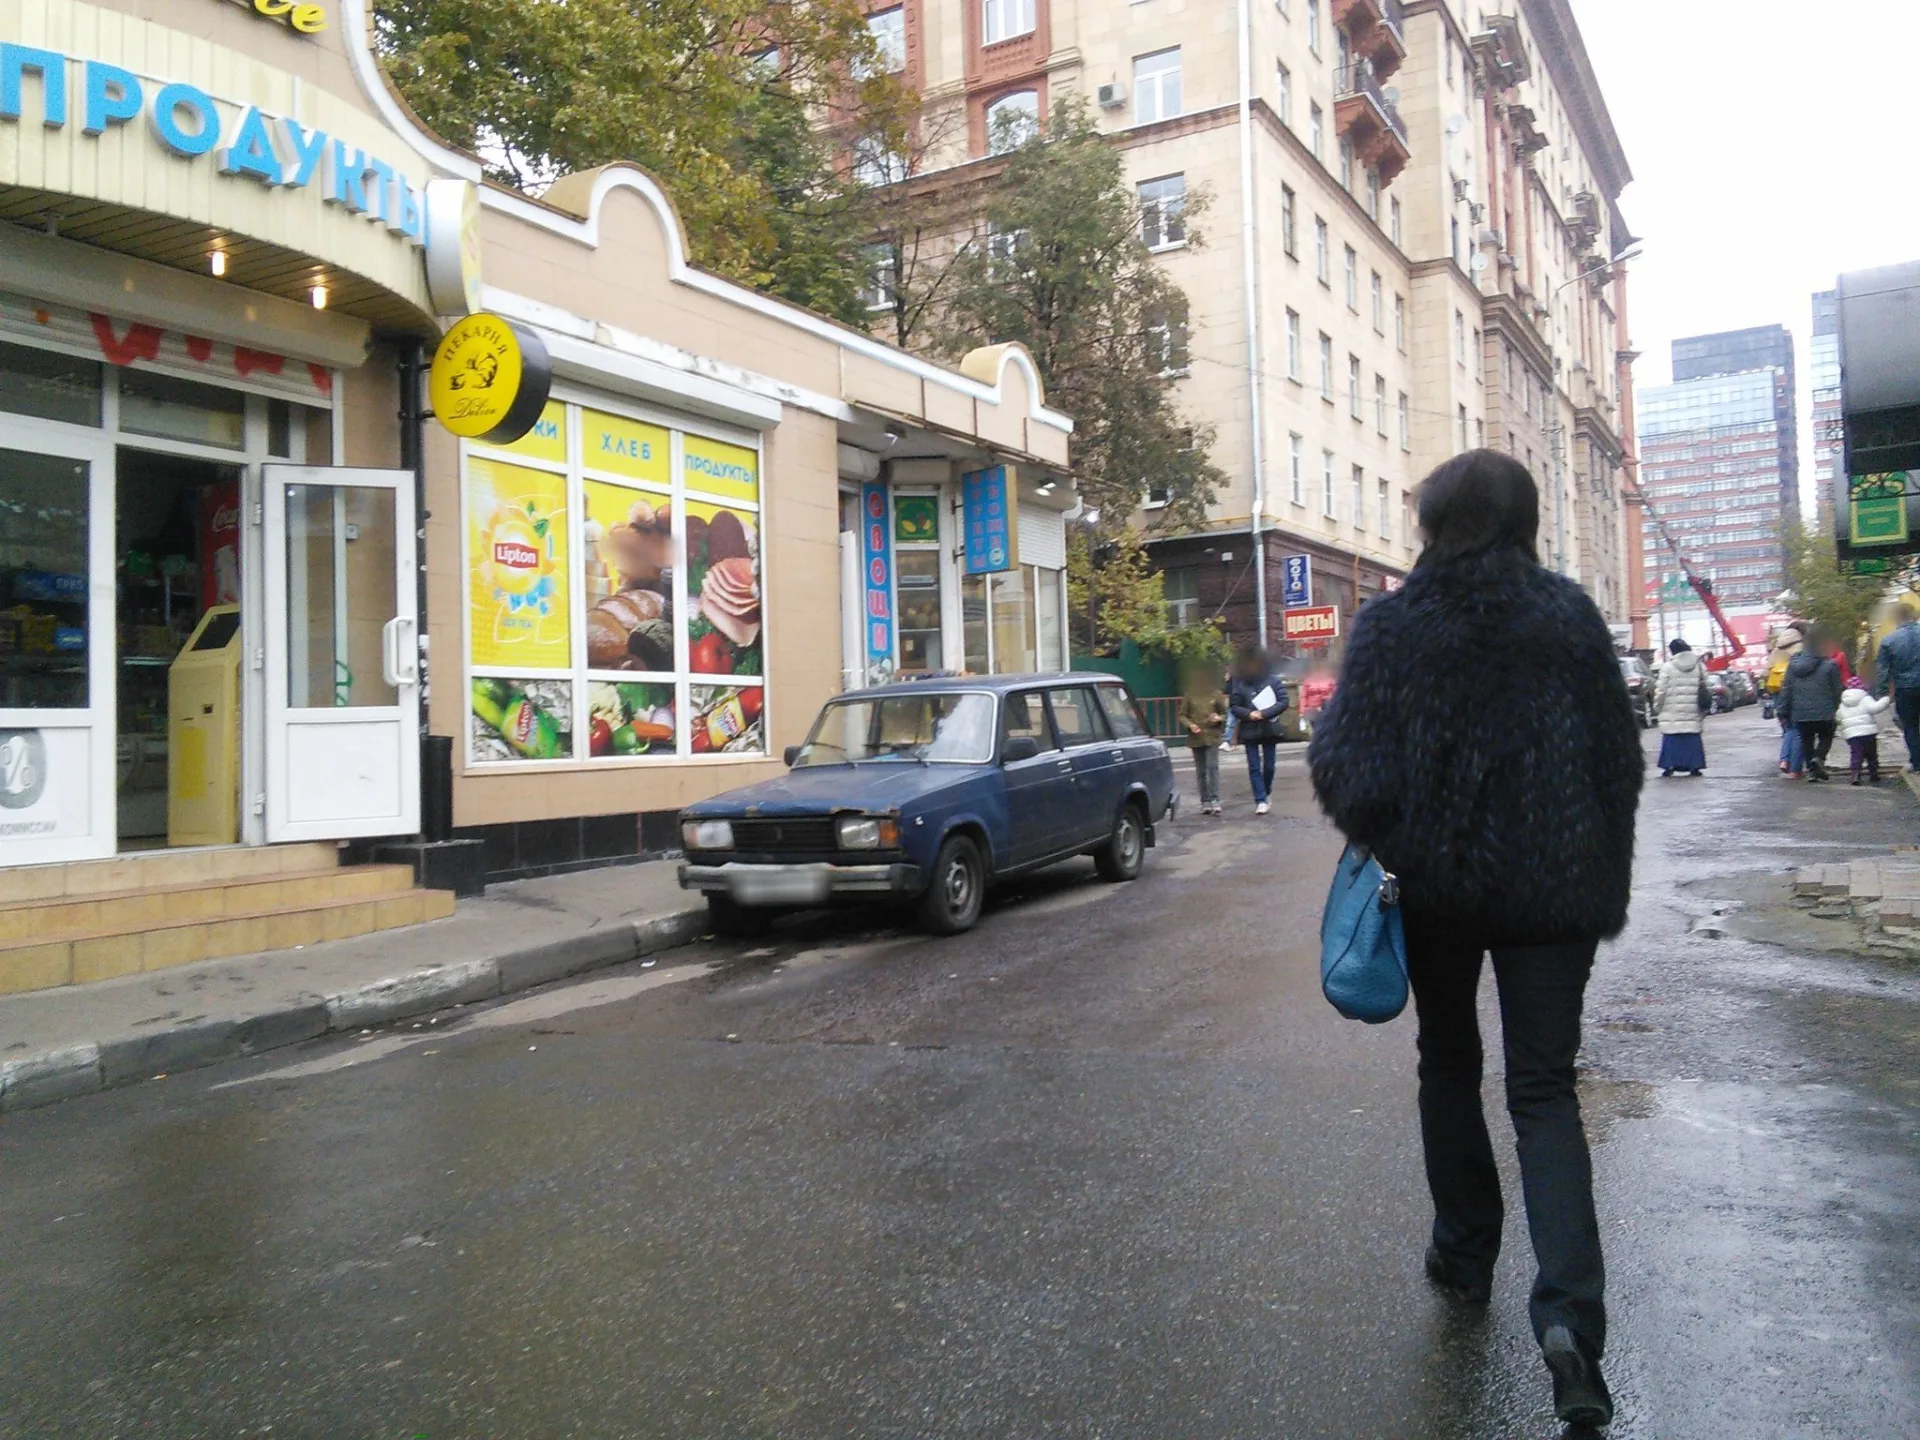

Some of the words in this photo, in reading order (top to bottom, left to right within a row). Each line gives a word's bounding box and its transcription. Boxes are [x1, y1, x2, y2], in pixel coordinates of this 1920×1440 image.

[0, 42, 431, 250] ПРОДУКТЫ
[443, 325, 508, 362] ПЕКАРНЯ
[601, 432, 651, 460] ХЛЕБ
[684, 453, 756, 485] ПРОДУКТЫ
[496, 545, 536, 564] Lipton
[867, 491, 890, 651] ОВОЩИ
[1286, 613, 1335, 634] ЦВЕТЫ
[515, 702, 532, 741] Lipton
